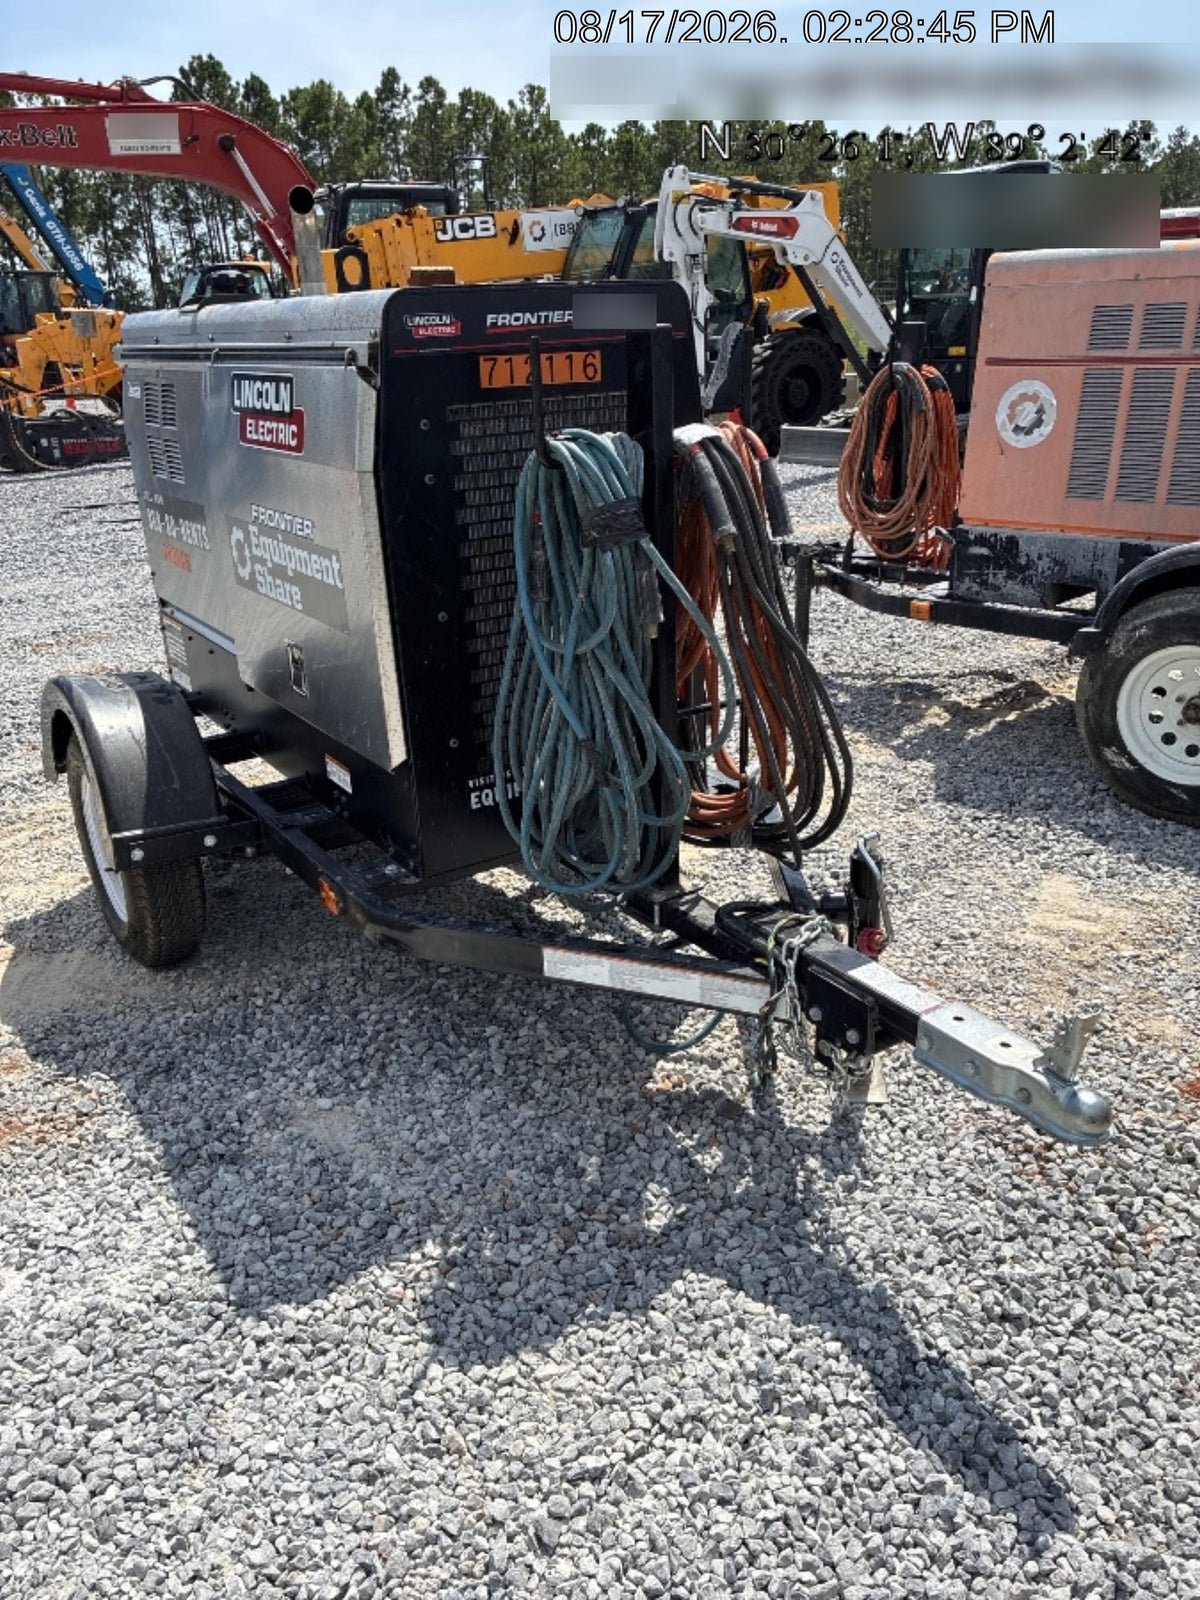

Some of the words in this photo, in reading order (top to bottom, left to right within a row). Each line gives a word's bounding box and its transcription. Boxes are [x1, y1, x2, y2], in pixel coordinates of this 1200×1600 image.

[436, 214, 497, 241] JCB
[406, 314, 451, 326] LINCOLN
[486, 309, 573, 328] FRONTIER
[233, 378, 292, 414] LINCOLN
[245, 417, 299, 447] ELECTRIC
[250, 502, 316, 542] FRONTIER
[247, 524, 344, 590] Equipment
[253, 562, 304, 611] Share
